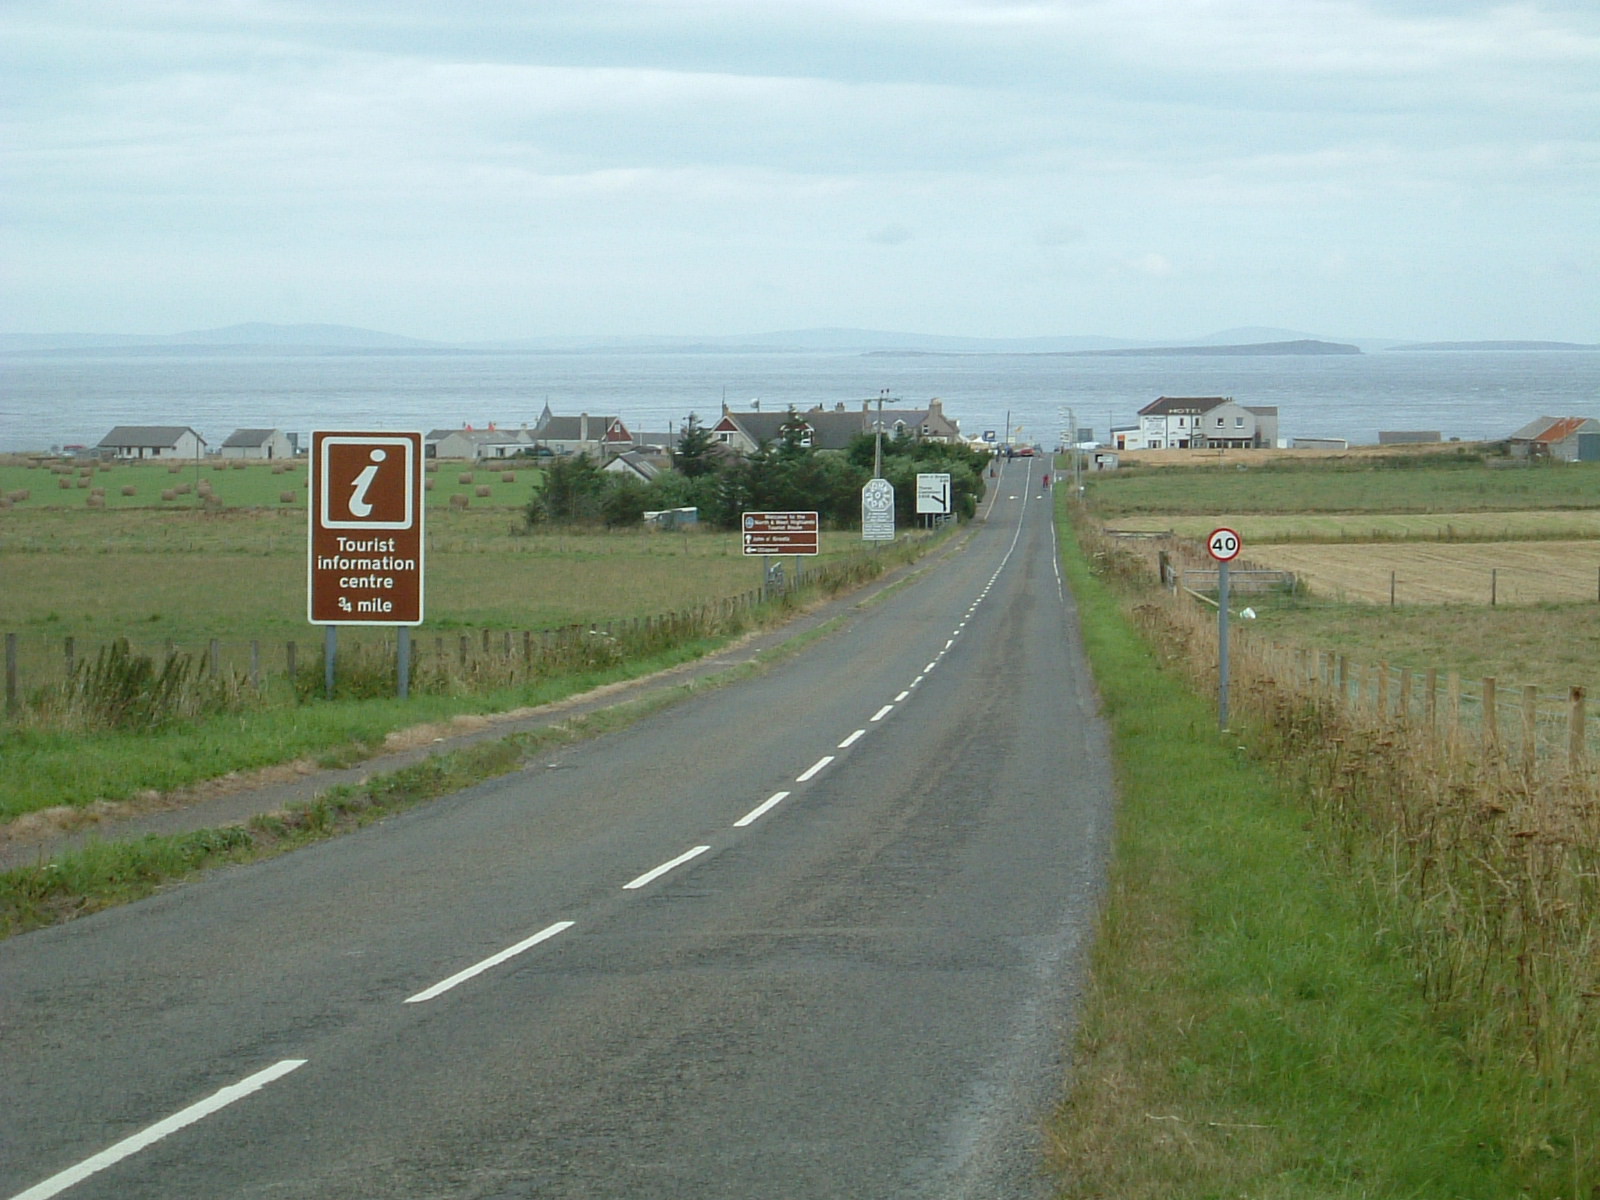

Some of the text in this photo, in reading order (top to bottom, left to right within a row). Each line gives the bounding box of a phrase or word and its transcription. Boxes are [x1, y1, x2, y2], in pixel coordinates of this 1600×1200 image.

[336, 537, 395, 552] Tourist
[1212, 537, 1236, 551] 40
[317, 556, 414, 571] information
[339, 574, 393, 588] centre
[357, 598, 392, 612] mile
